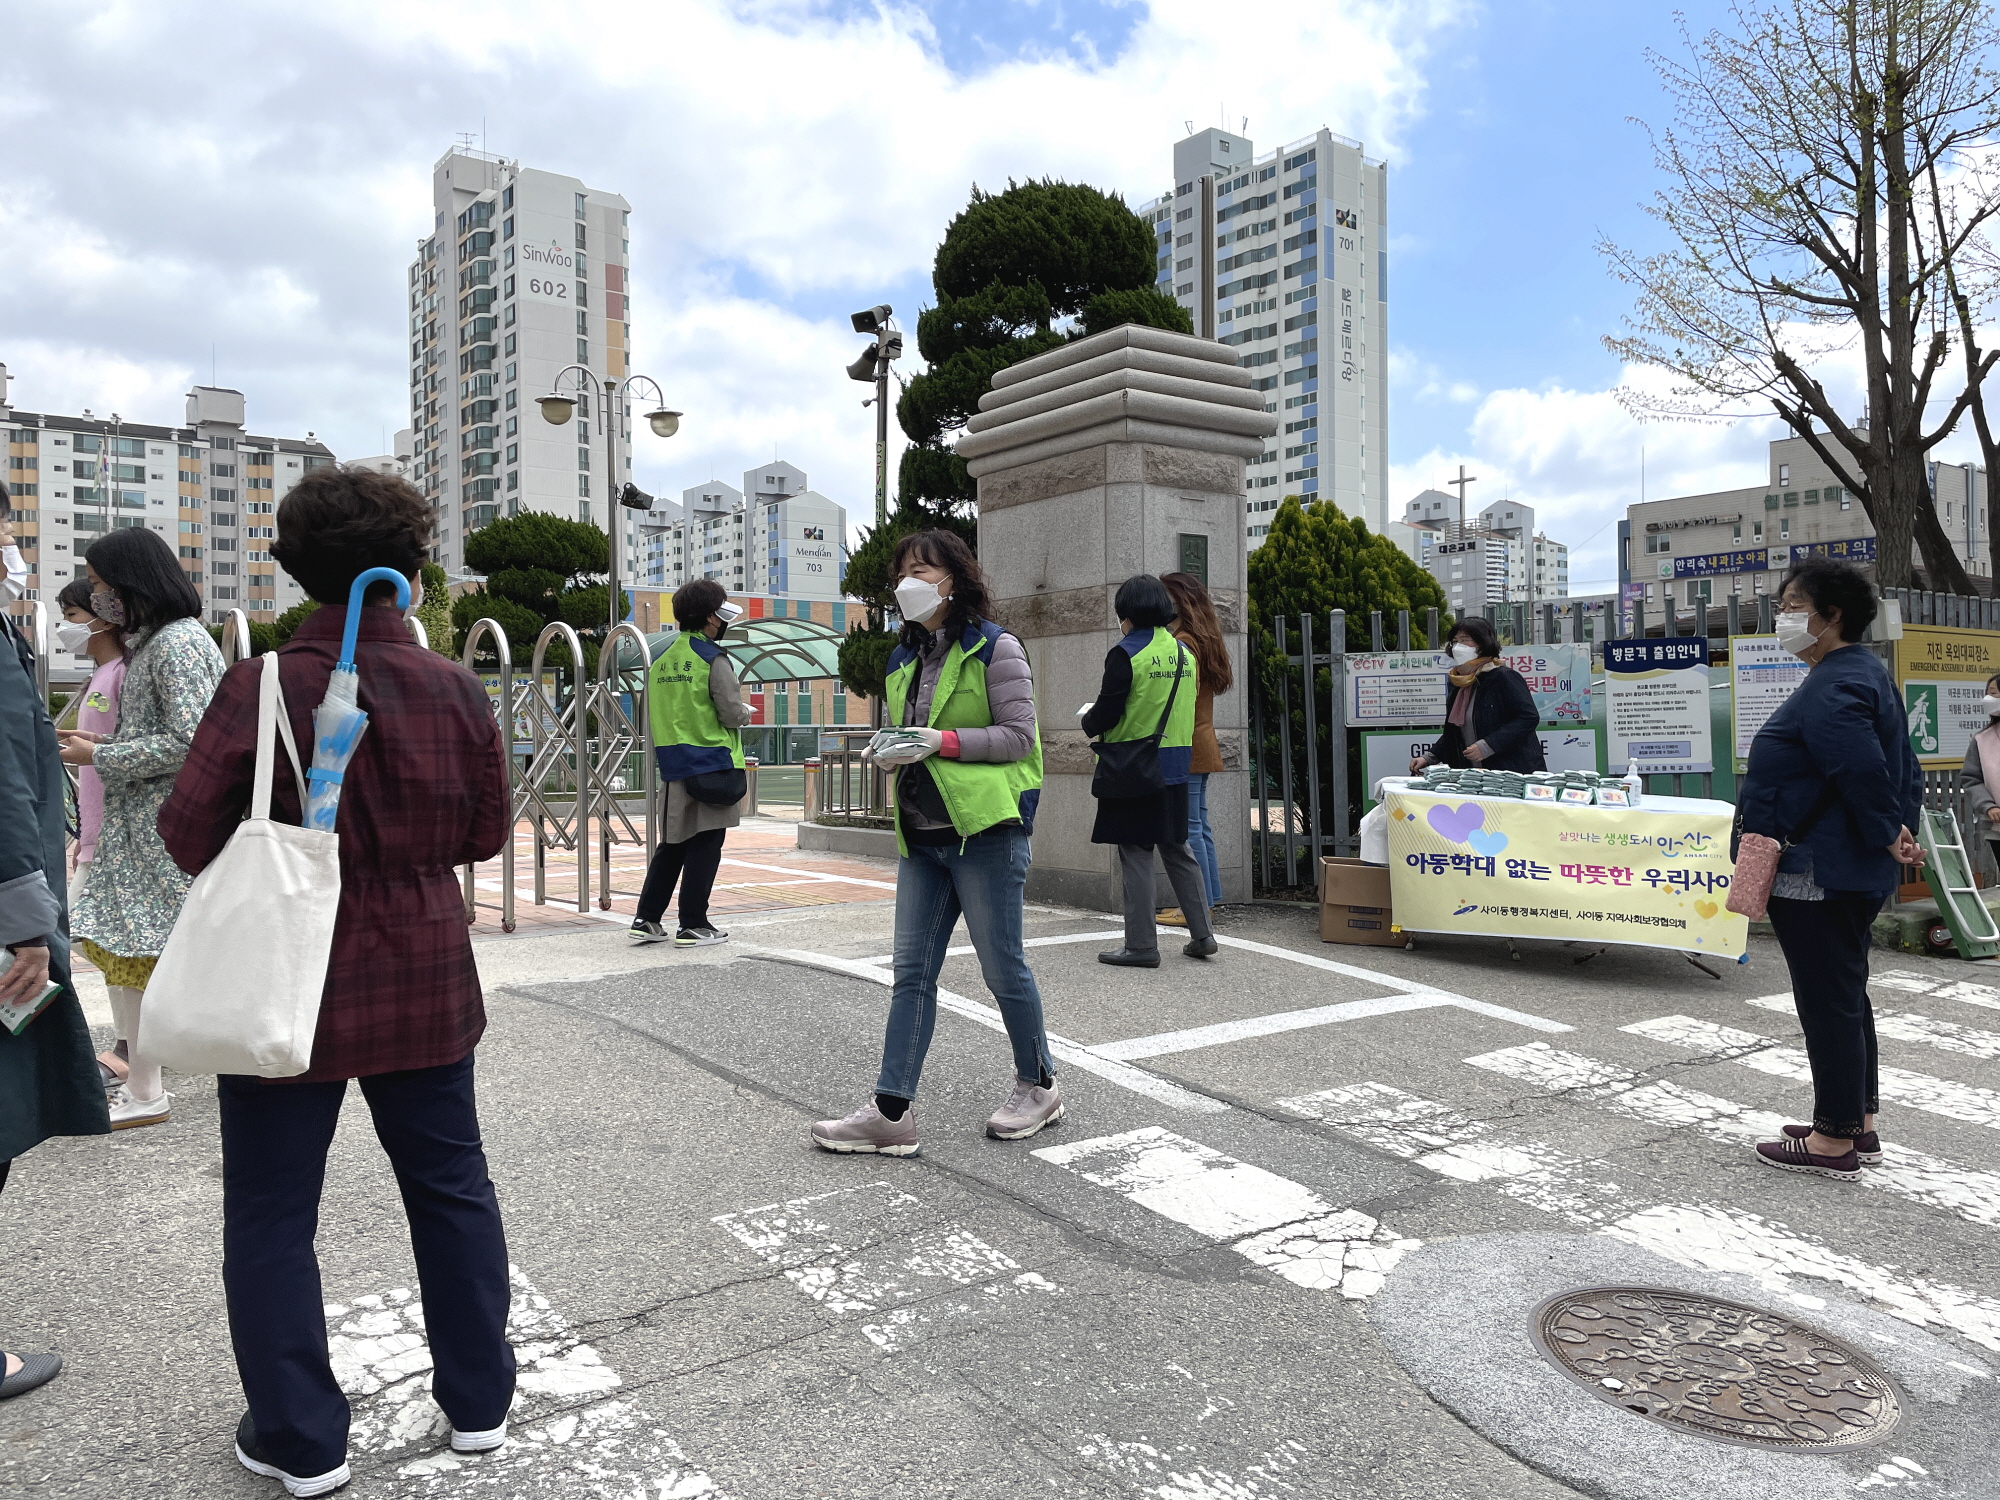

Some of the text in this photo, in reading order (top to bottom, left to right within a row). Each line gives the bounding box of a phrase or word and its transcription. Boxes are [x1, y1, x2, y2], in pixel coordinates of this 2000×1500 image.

[1339, 237, 1354, 251] 701
[523, 244, 572, 268] SinWoo
[530, 278, 567, 299] 602
[1342, 288, 1358, 382] 월드메르디앙
[795, 544, 832, 558] Meridian
[1438, 541, 1476, 554] 대은교회
[1736, 551, 1767, 565] 소아과
[806, 563, 823, 573] 703
[1612, 644, 1700, 662] 방문객 출입안내
[1927, 642, 1989, 662] 지진 옥외대피장소
[1353, 657, 1433, 670] CCTV 설치안내
[1910, 662, 1939, 671] EMERGENCY
[1941, 663, 1964, 672] ASSEMBLY
[1966, 664, 1977, 673] AREA
[1559, 831, 1601, 843] 살맛나는
[1604, 833, 1652, 846] 생생도시
[1406, 853, 1496, 877] 아동학대
[1505, 858, 1552, 881] 없는
[1559, 863, 1634, 886] 따뜻한
[1576, 910, 1604, 921] 사이동
[1606, 912, 1686, 929] 지역사회보장협의체
